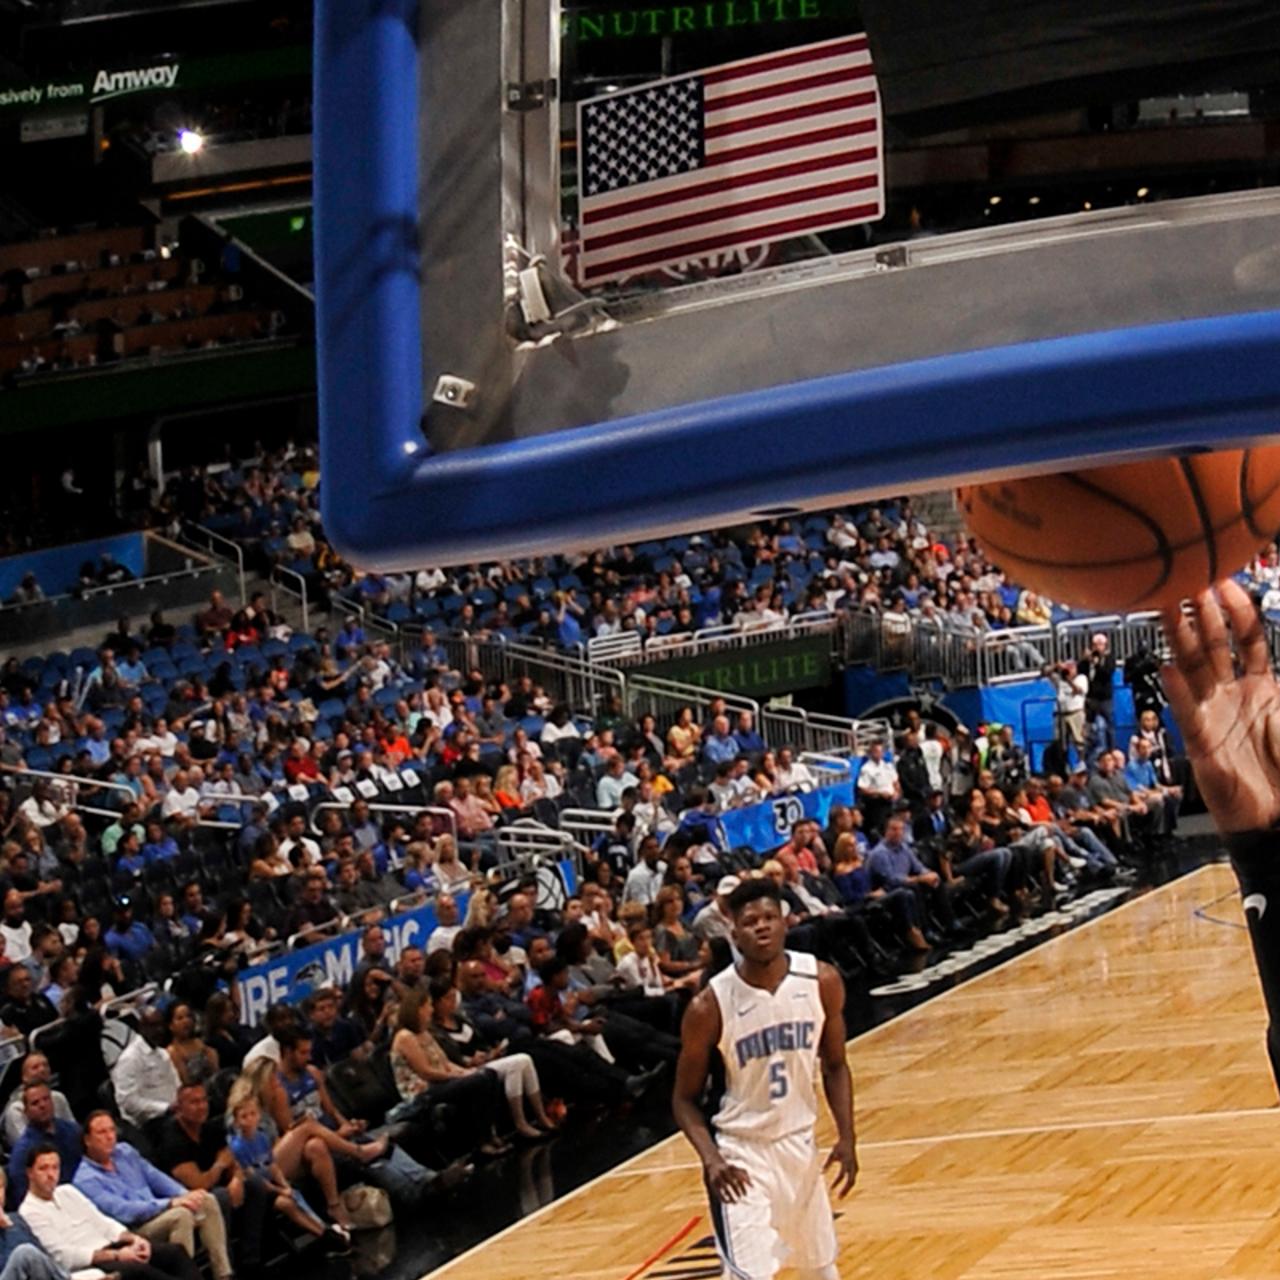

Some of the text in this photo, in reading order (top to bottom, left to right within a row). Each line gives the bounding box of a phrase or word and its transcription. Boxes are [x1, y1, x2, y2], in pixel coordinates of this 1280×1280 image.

[578, 0, 822, 40] NUTRILITE
[47, 83, 84, 99] from
[92, 64, 180, 94] Amway
[736, 1021, 815, 1069] MAGIC
[769, 1060, 789, 1100] 5
